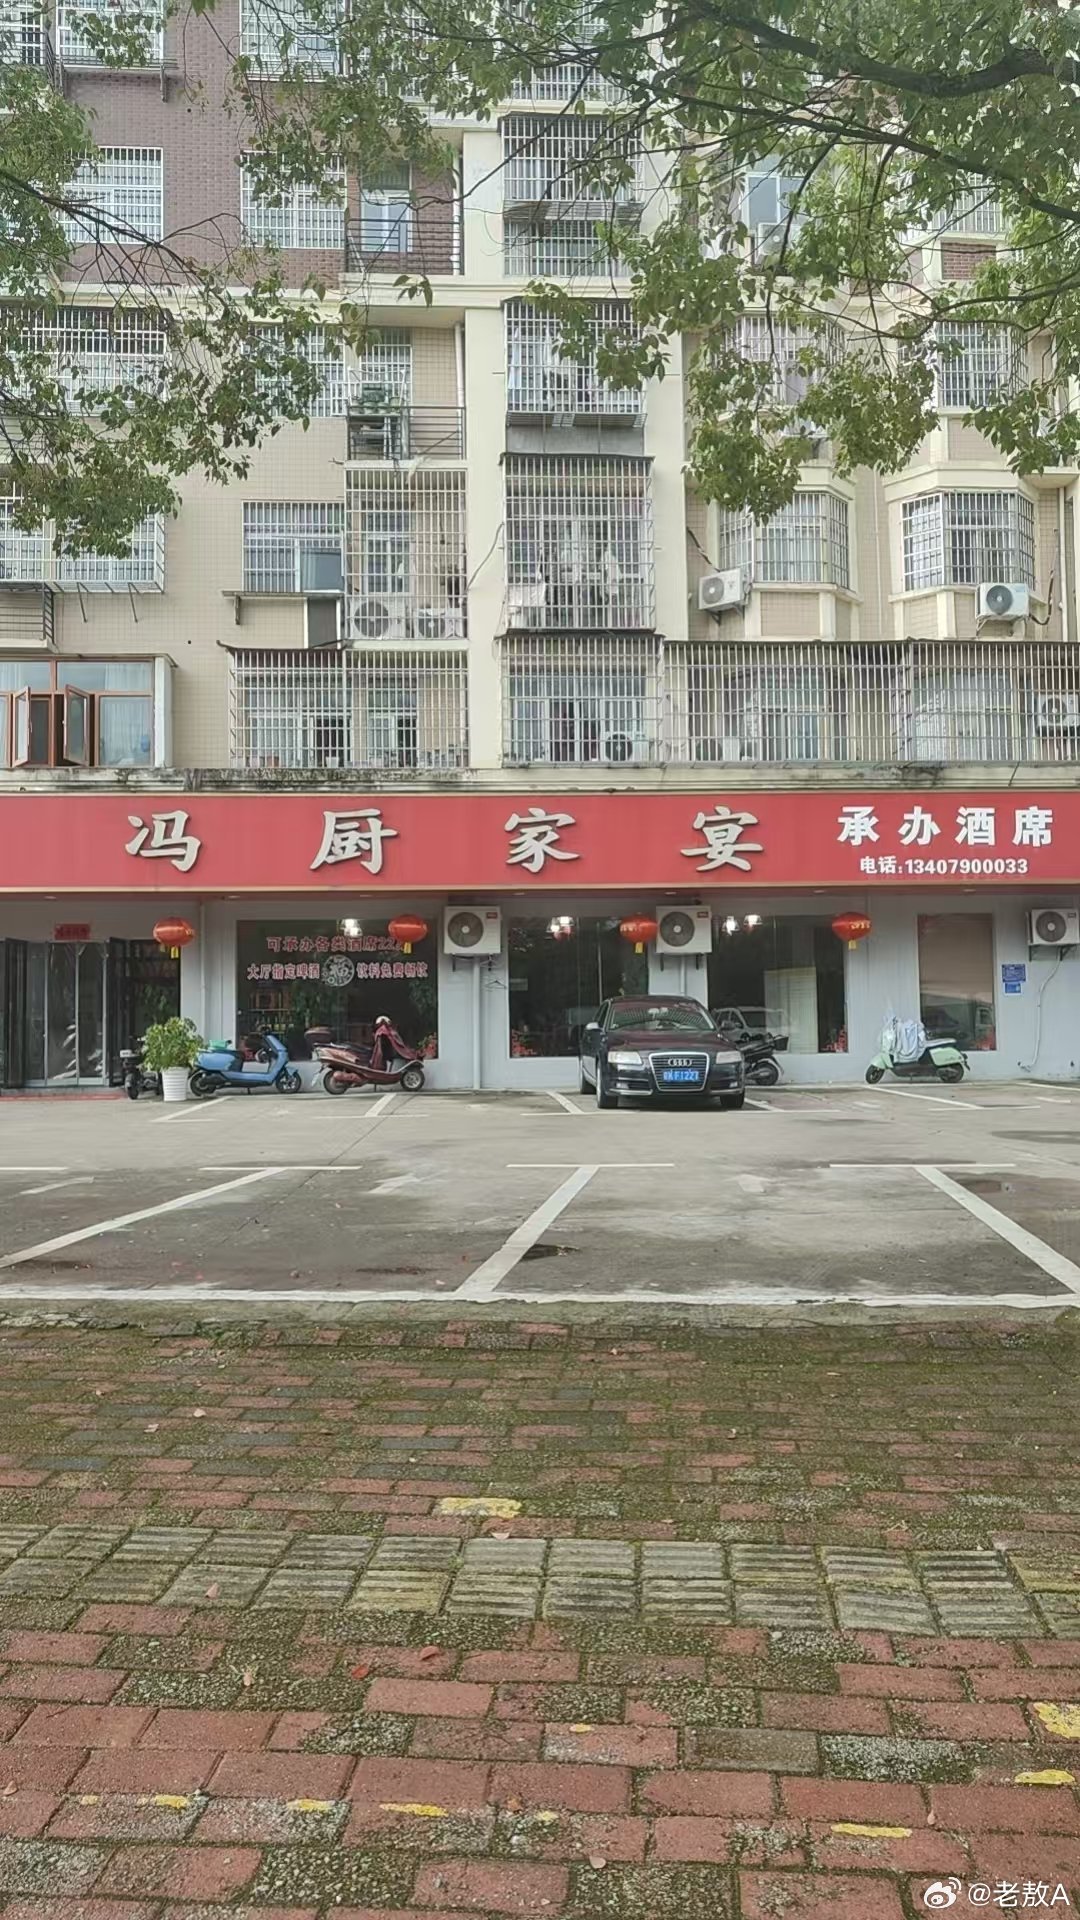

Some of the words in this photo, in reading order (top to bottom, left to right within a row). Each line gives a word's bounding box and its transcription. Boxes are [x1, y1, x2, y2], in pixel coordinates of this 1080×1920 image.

[124, 806, 764, 874] 冯厨家宴
[836, 805, 1053, 847] 承办酒席
[859, 855, 1028, 875] 电话:13407900033
